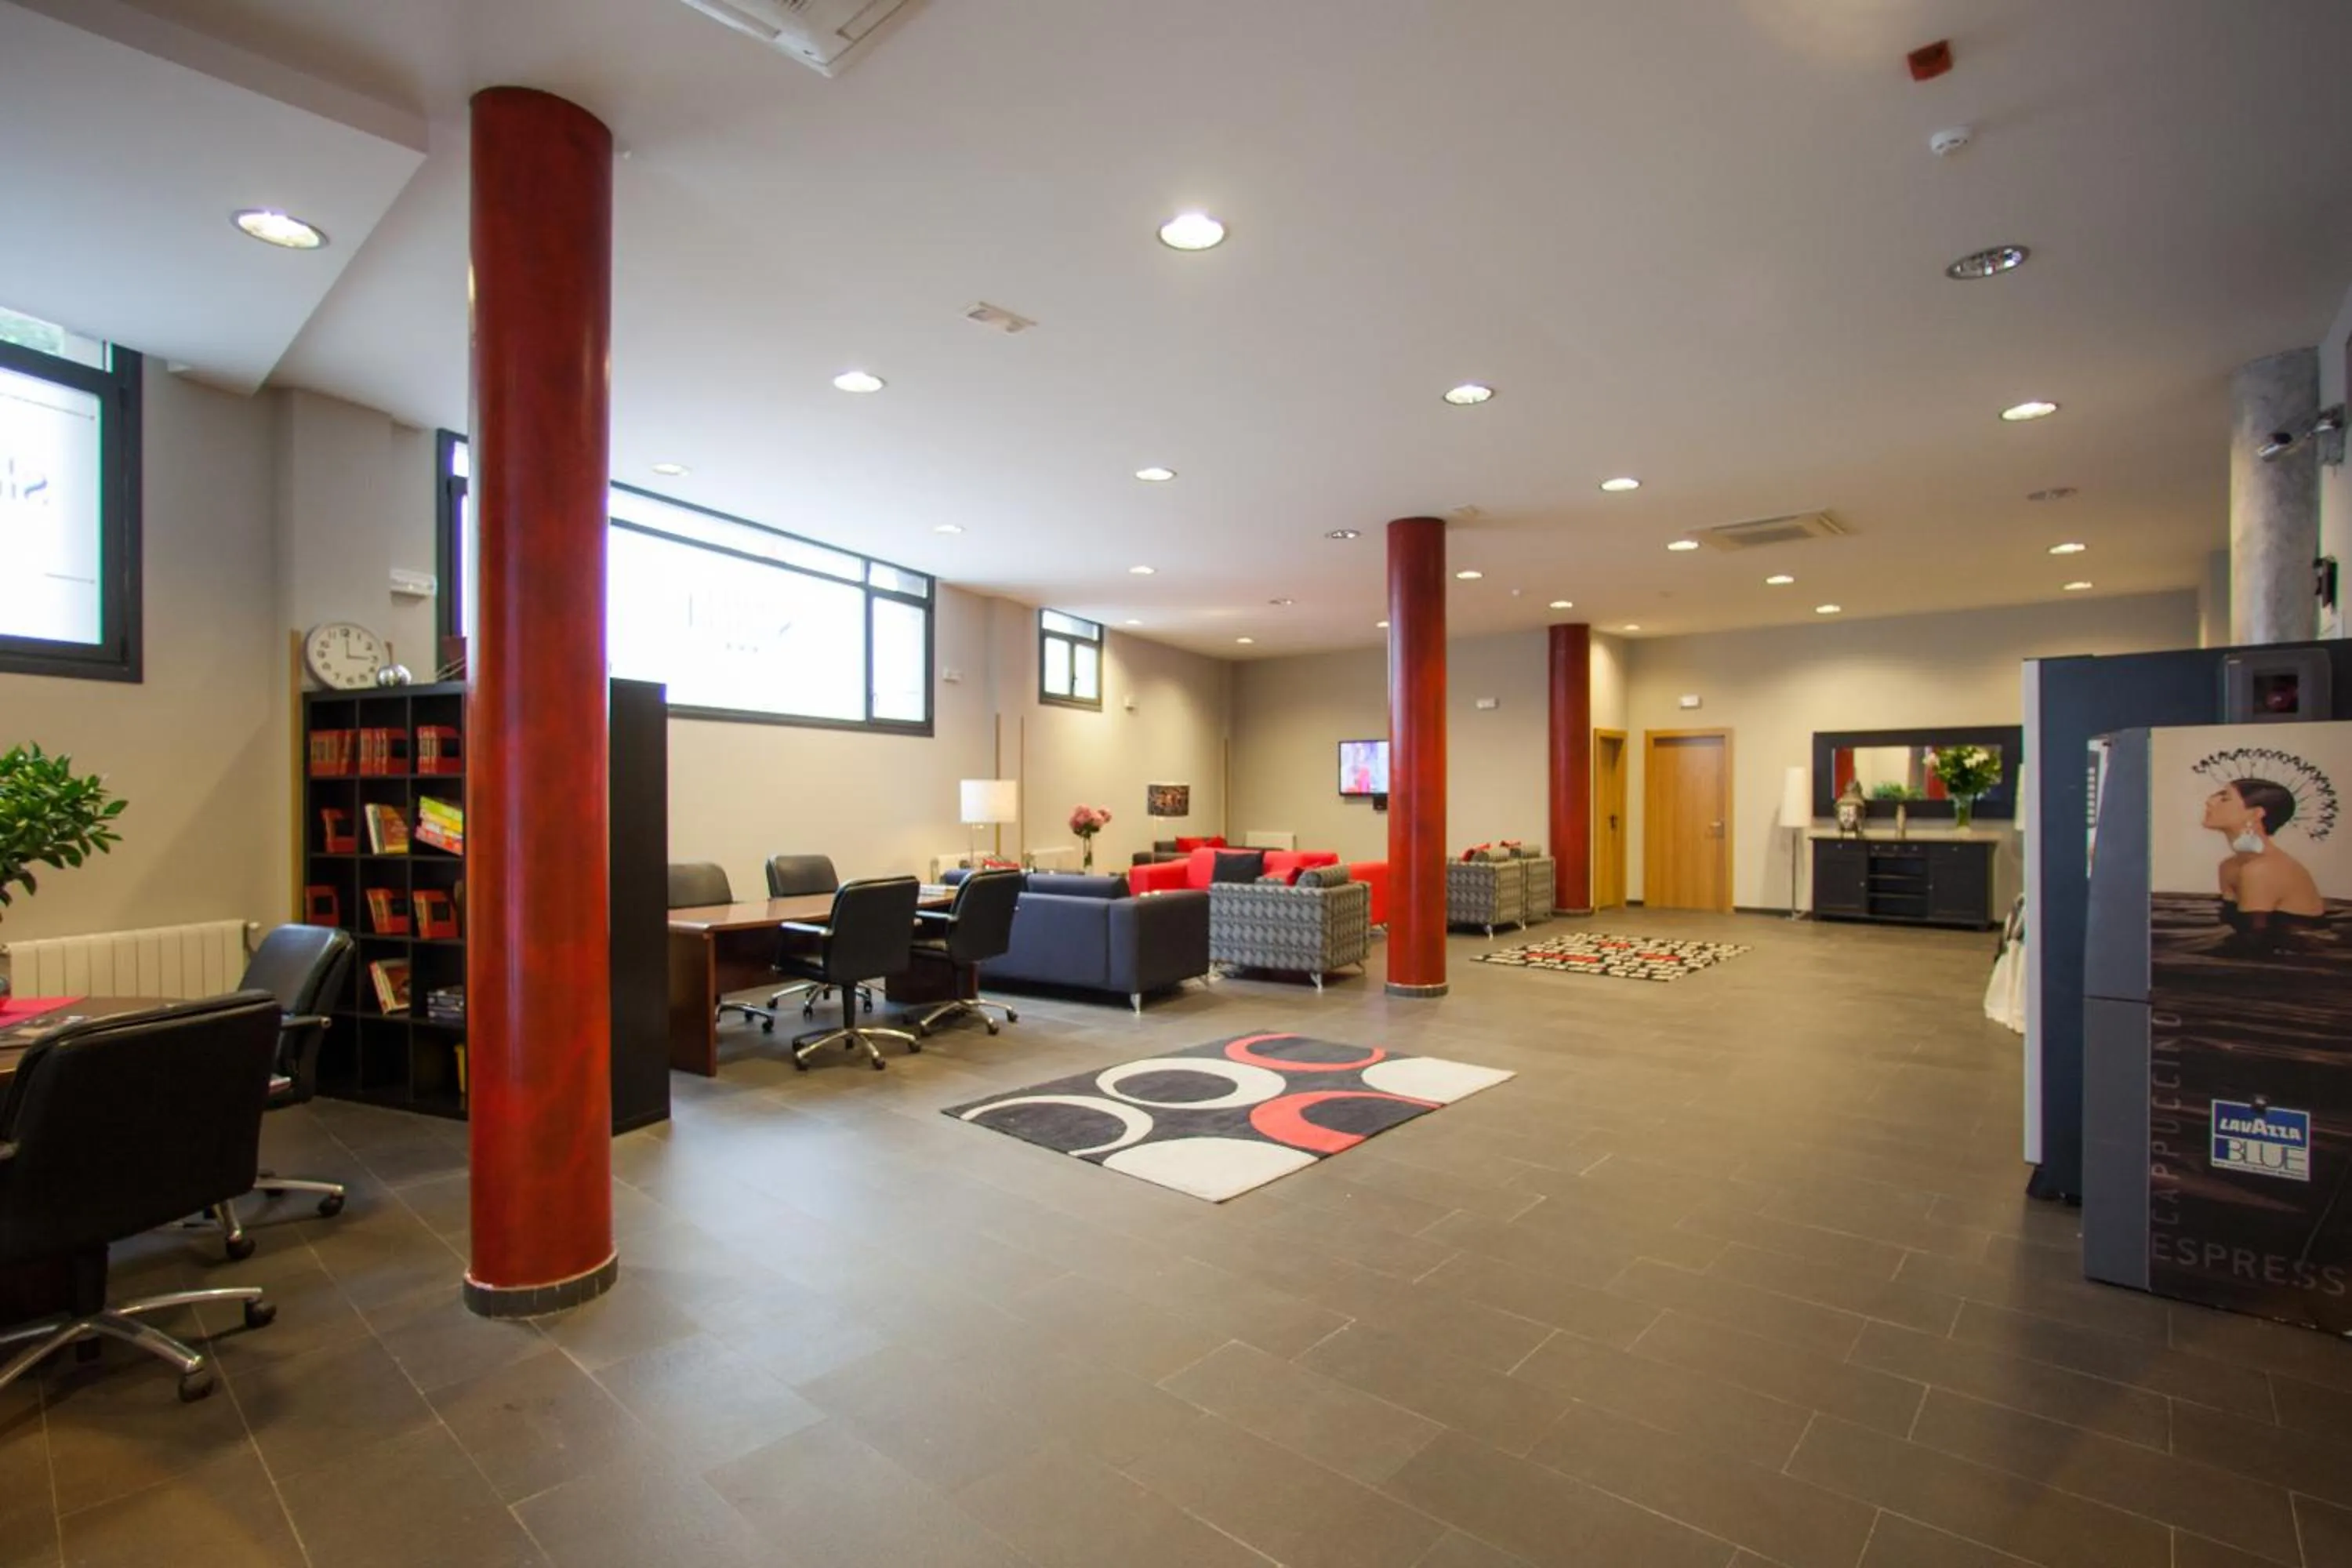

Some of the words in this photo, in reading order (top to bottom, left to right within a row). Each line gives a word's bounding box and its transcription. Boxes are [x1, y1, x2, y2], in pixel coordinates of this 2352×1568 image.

[2151, 1011, 2183, 1225] CAPPUCCINO
[2220, 1116, 2303, 1142] LAVAZZA
[2227, 1138, 2306, 1173] BLUE
